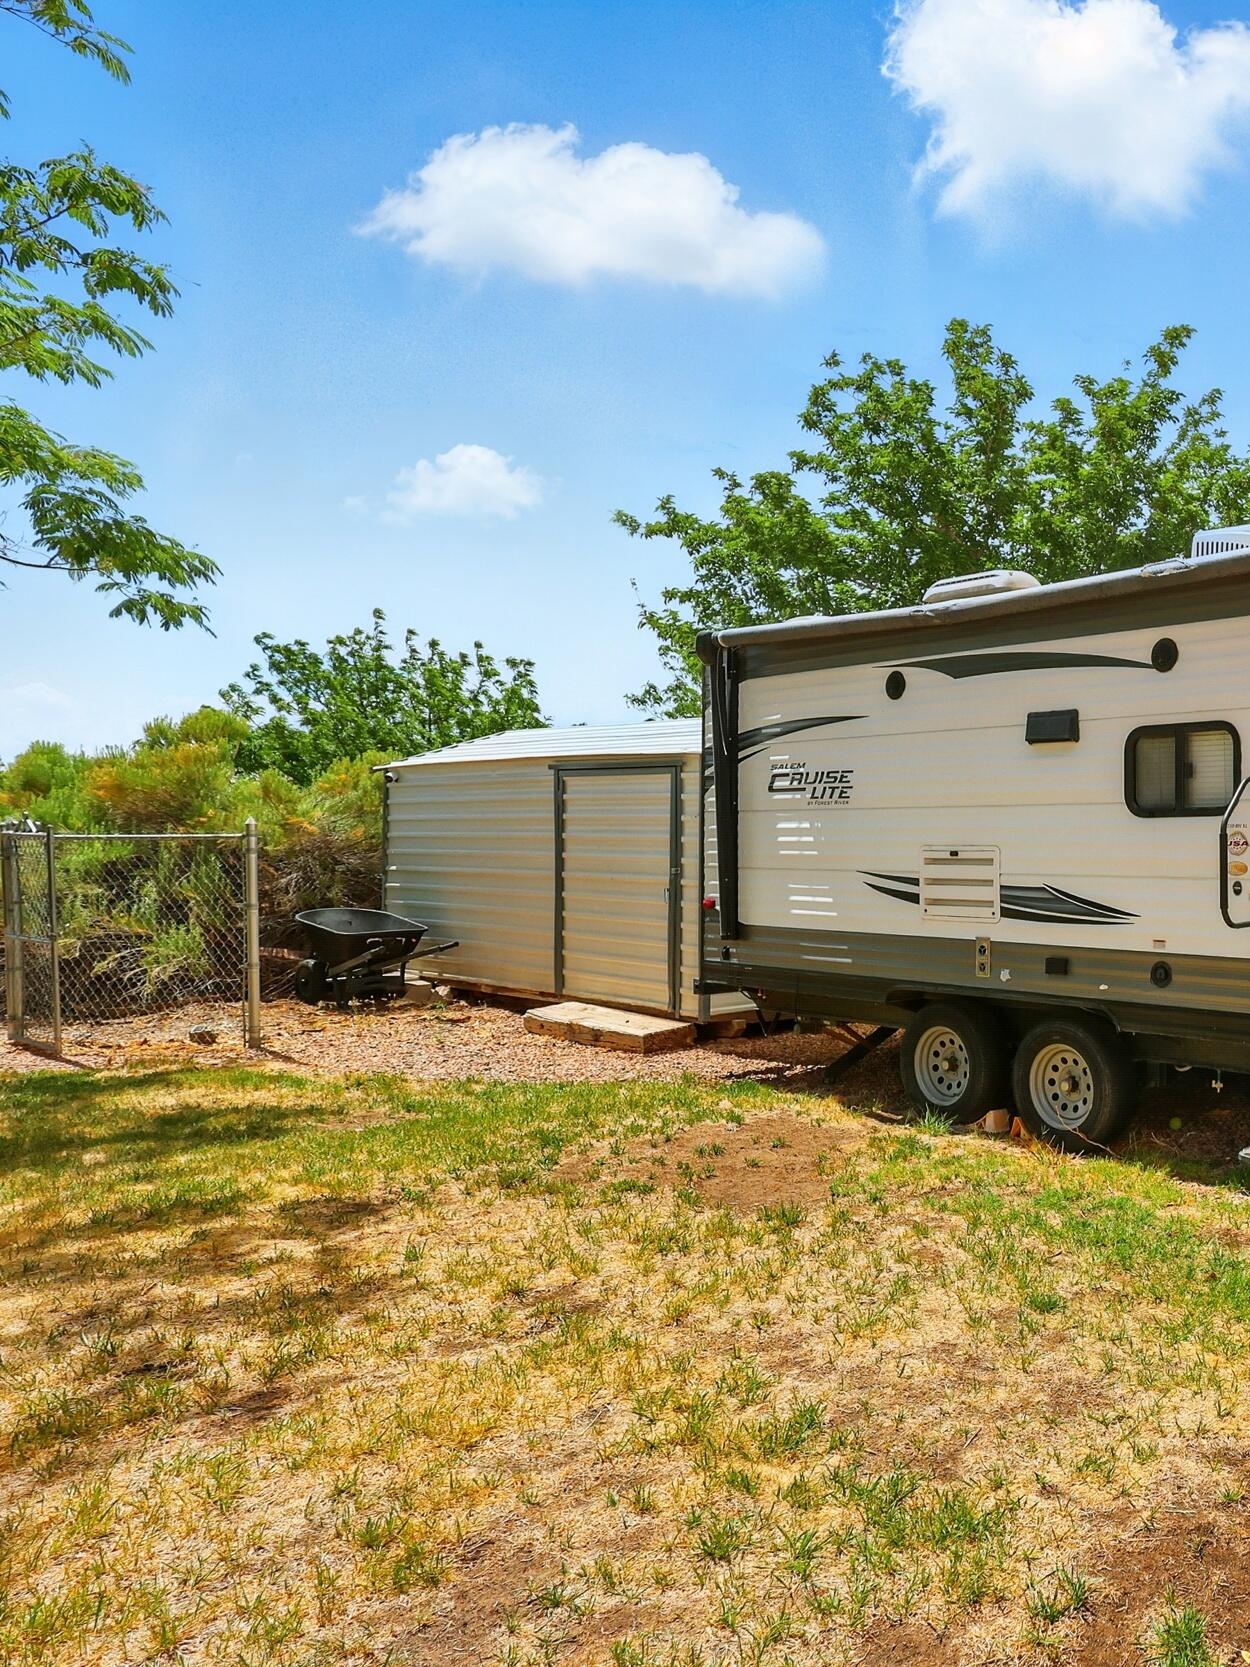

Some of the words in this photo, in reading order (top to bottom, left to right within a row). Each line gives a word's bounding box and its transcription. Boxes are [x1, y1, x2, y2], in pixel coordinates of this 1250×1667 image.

[770, 762, 806, 770] SALEM
[768, 770, 854, 793] CRUISE
[810, 786, 854, 799] LITE
